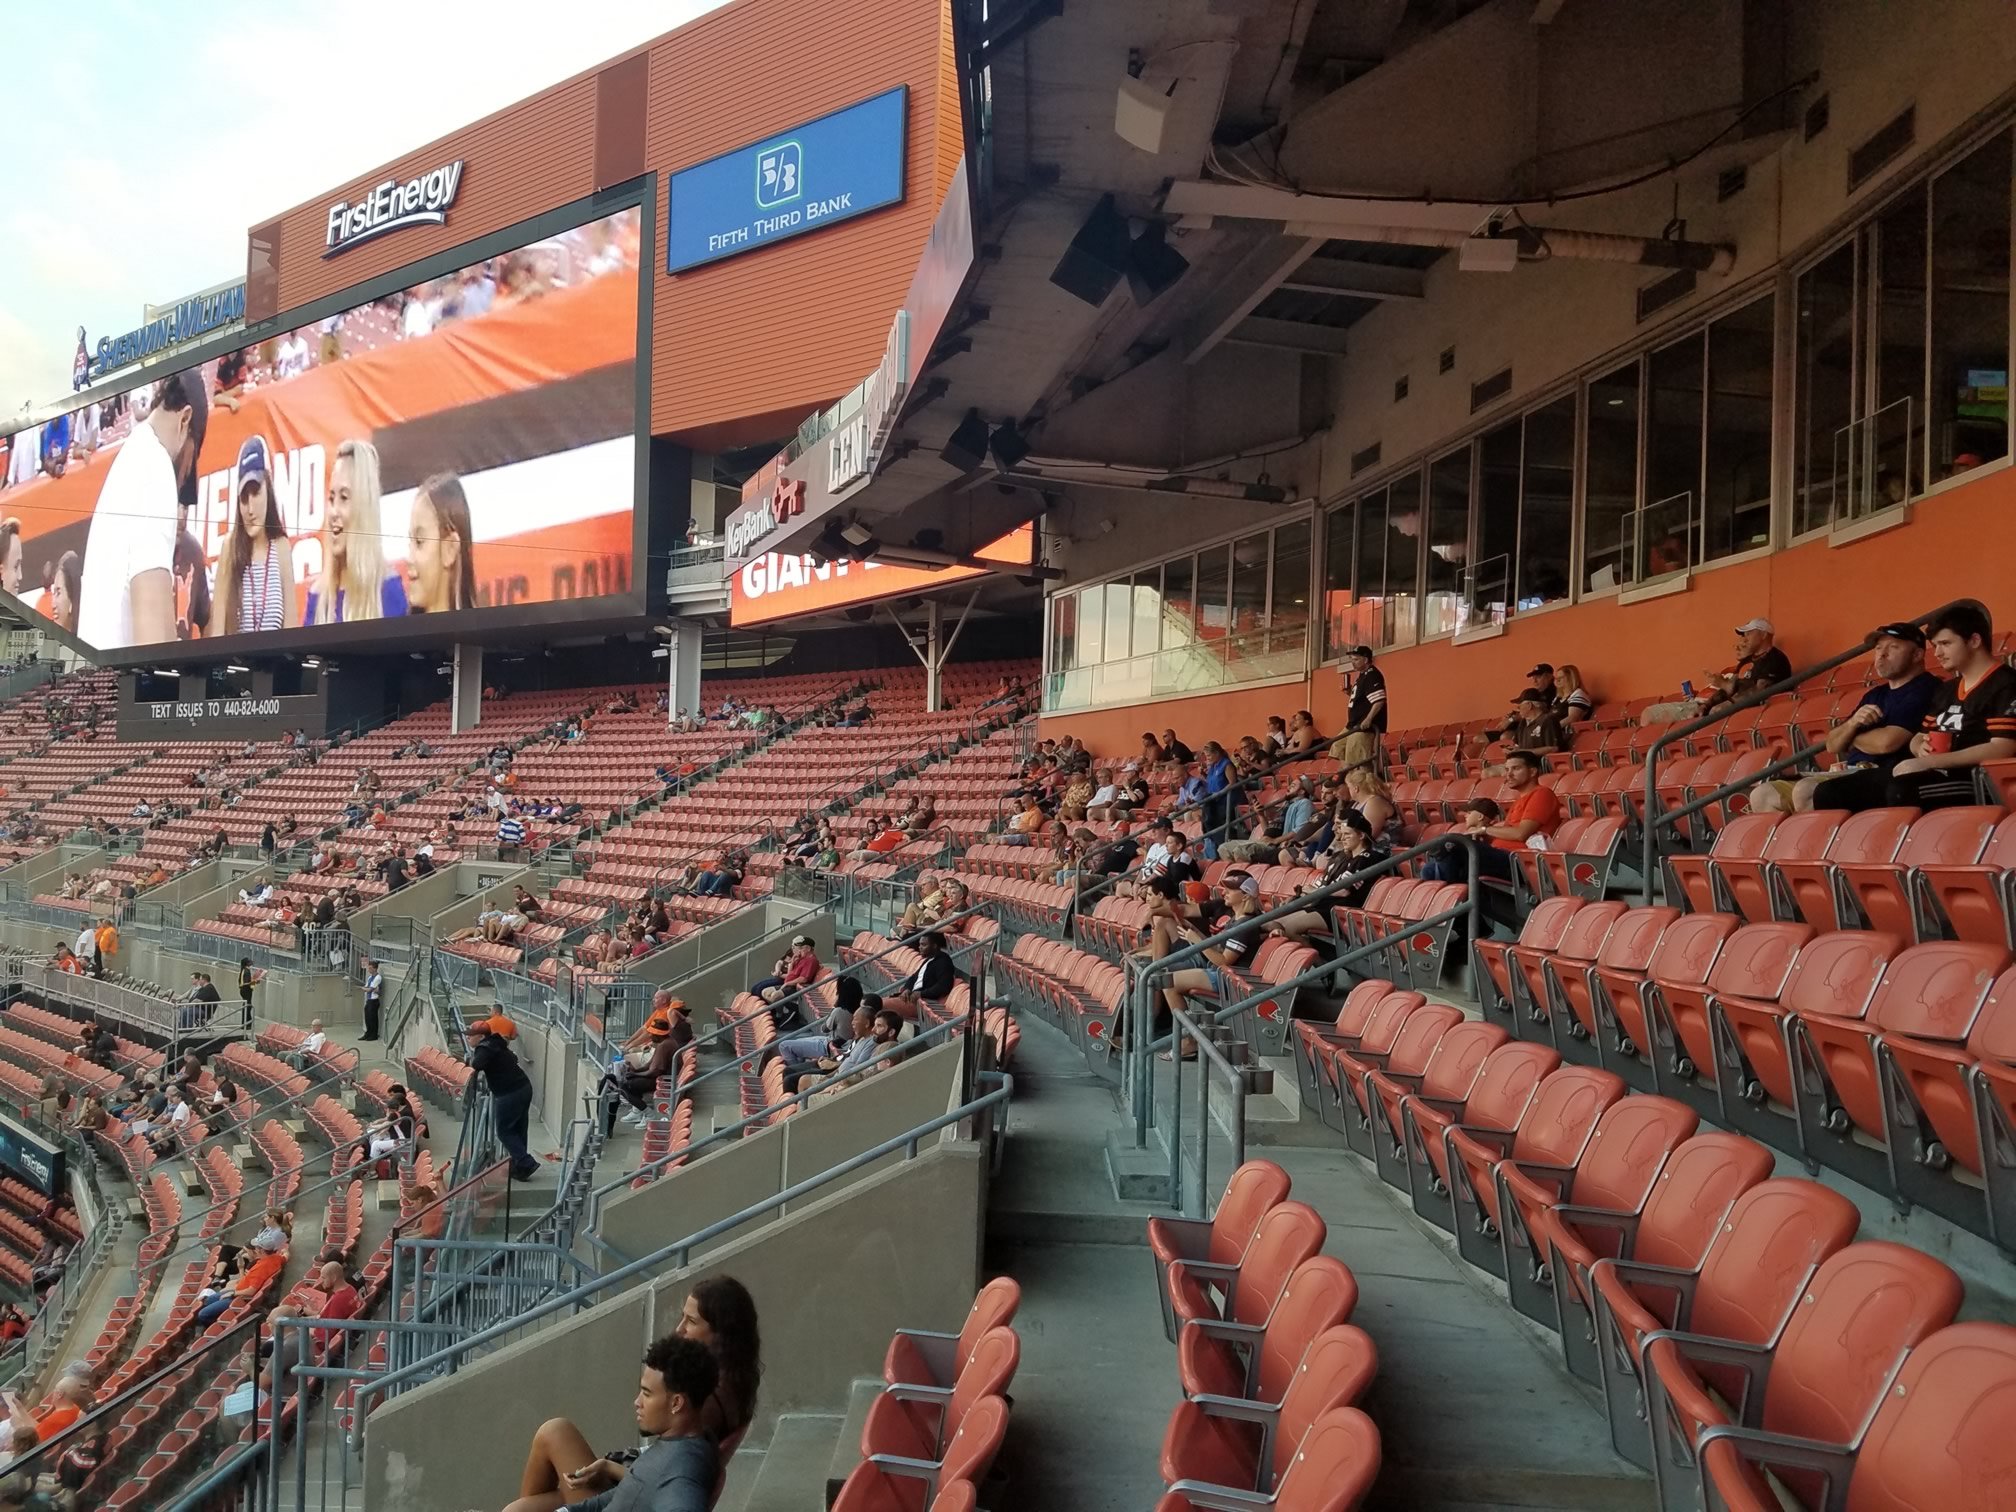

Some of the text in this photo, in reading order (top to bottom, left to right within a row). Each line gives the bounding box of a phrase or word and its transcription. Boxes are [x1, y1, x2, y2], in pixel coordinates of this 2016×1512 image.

[326, 160, 464, 247] FirstEnergy
[708, 192, 852, 251] FIFTH THIRD BANK
[727, 497, 774, 558] KeyBank
[151, 699, 280, 718] TEXT ISSUES TO 440-824-6000
